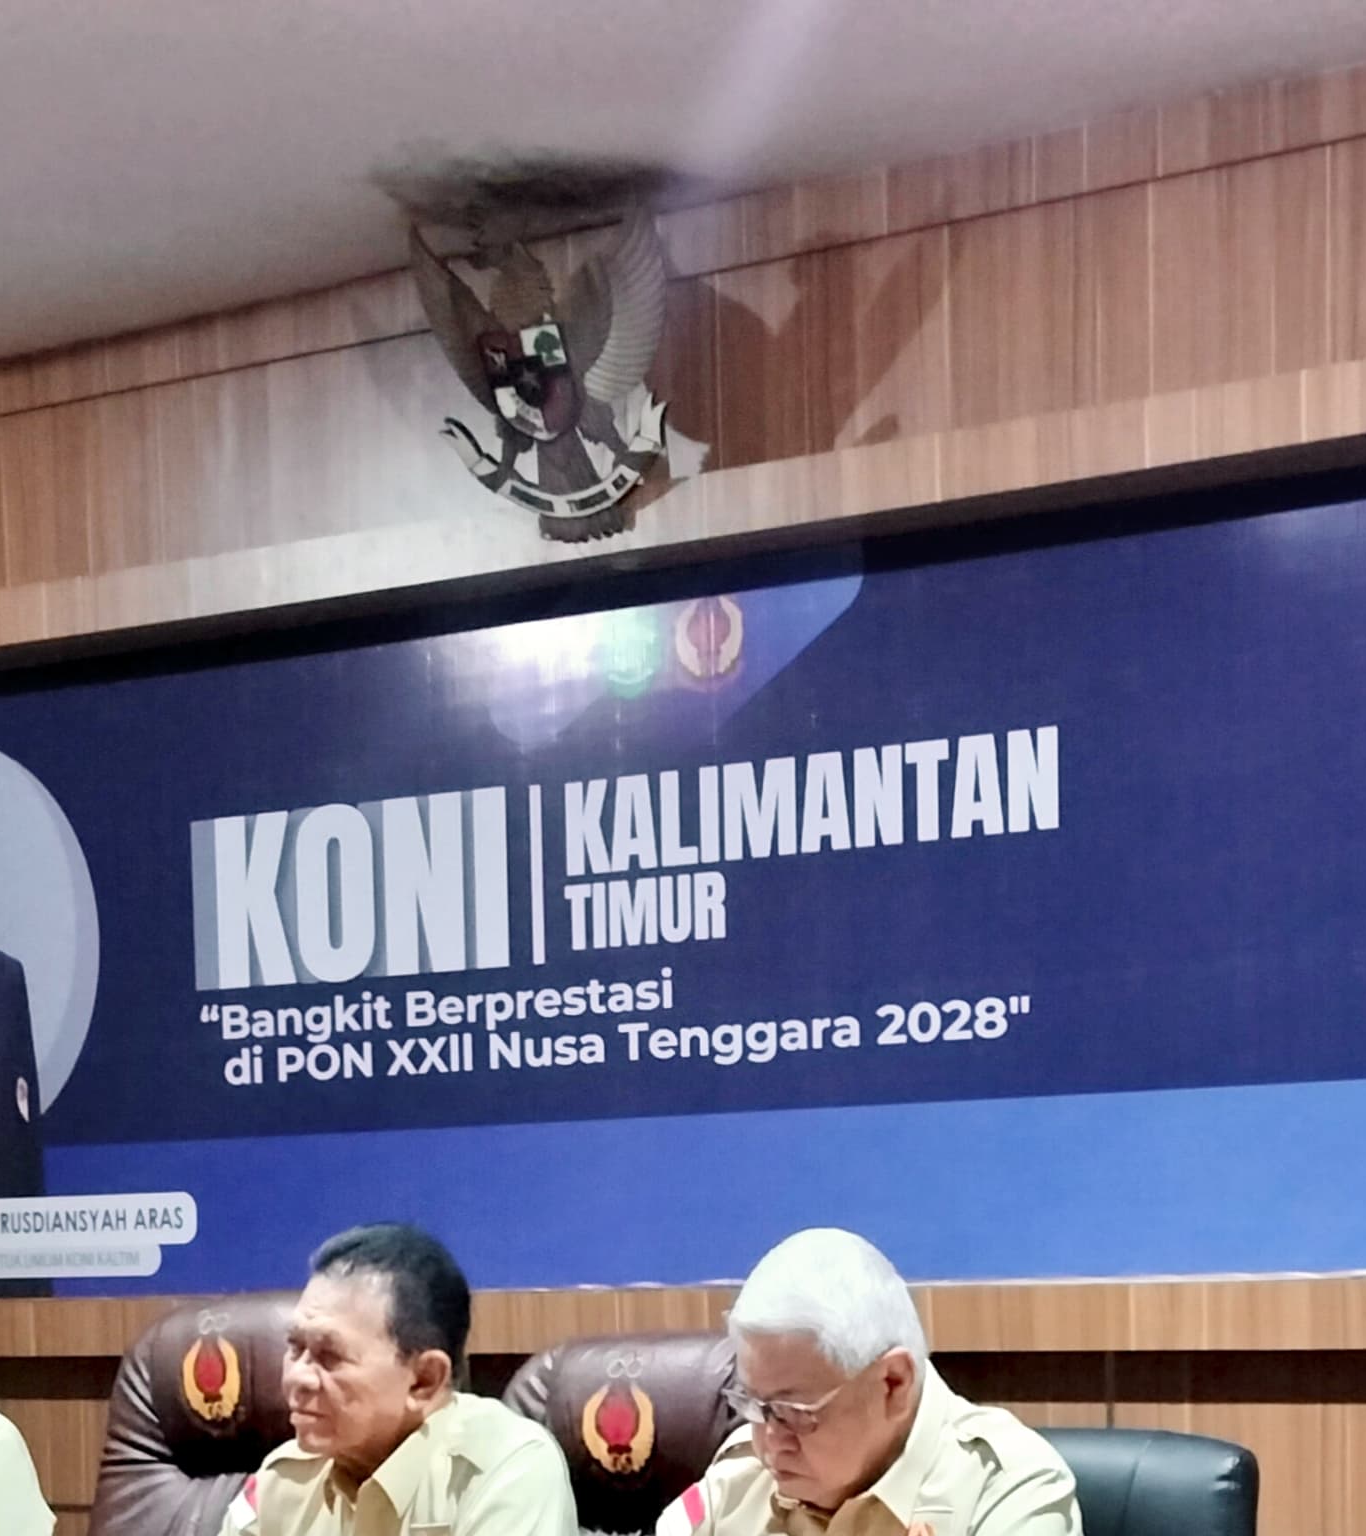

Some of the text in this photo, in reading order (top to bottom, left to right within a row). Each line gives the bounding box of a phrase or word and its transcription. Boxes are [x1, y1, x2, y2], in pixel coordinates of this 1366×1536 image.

[565, 725, 1059, 876] KALIMANTAN
[207, 787, 510, 989] KONI
[564, 871, 726, 951] TIMUR
[224, 995, 1030, 1085] di PON XXII Nusa Tenggara 2028"
[407, 967, 673, 1030] Berprestasi
[0, 1208, 127, 1234] RUSDIANSYAH
[133, 1206, 184, 1230] ARAS
